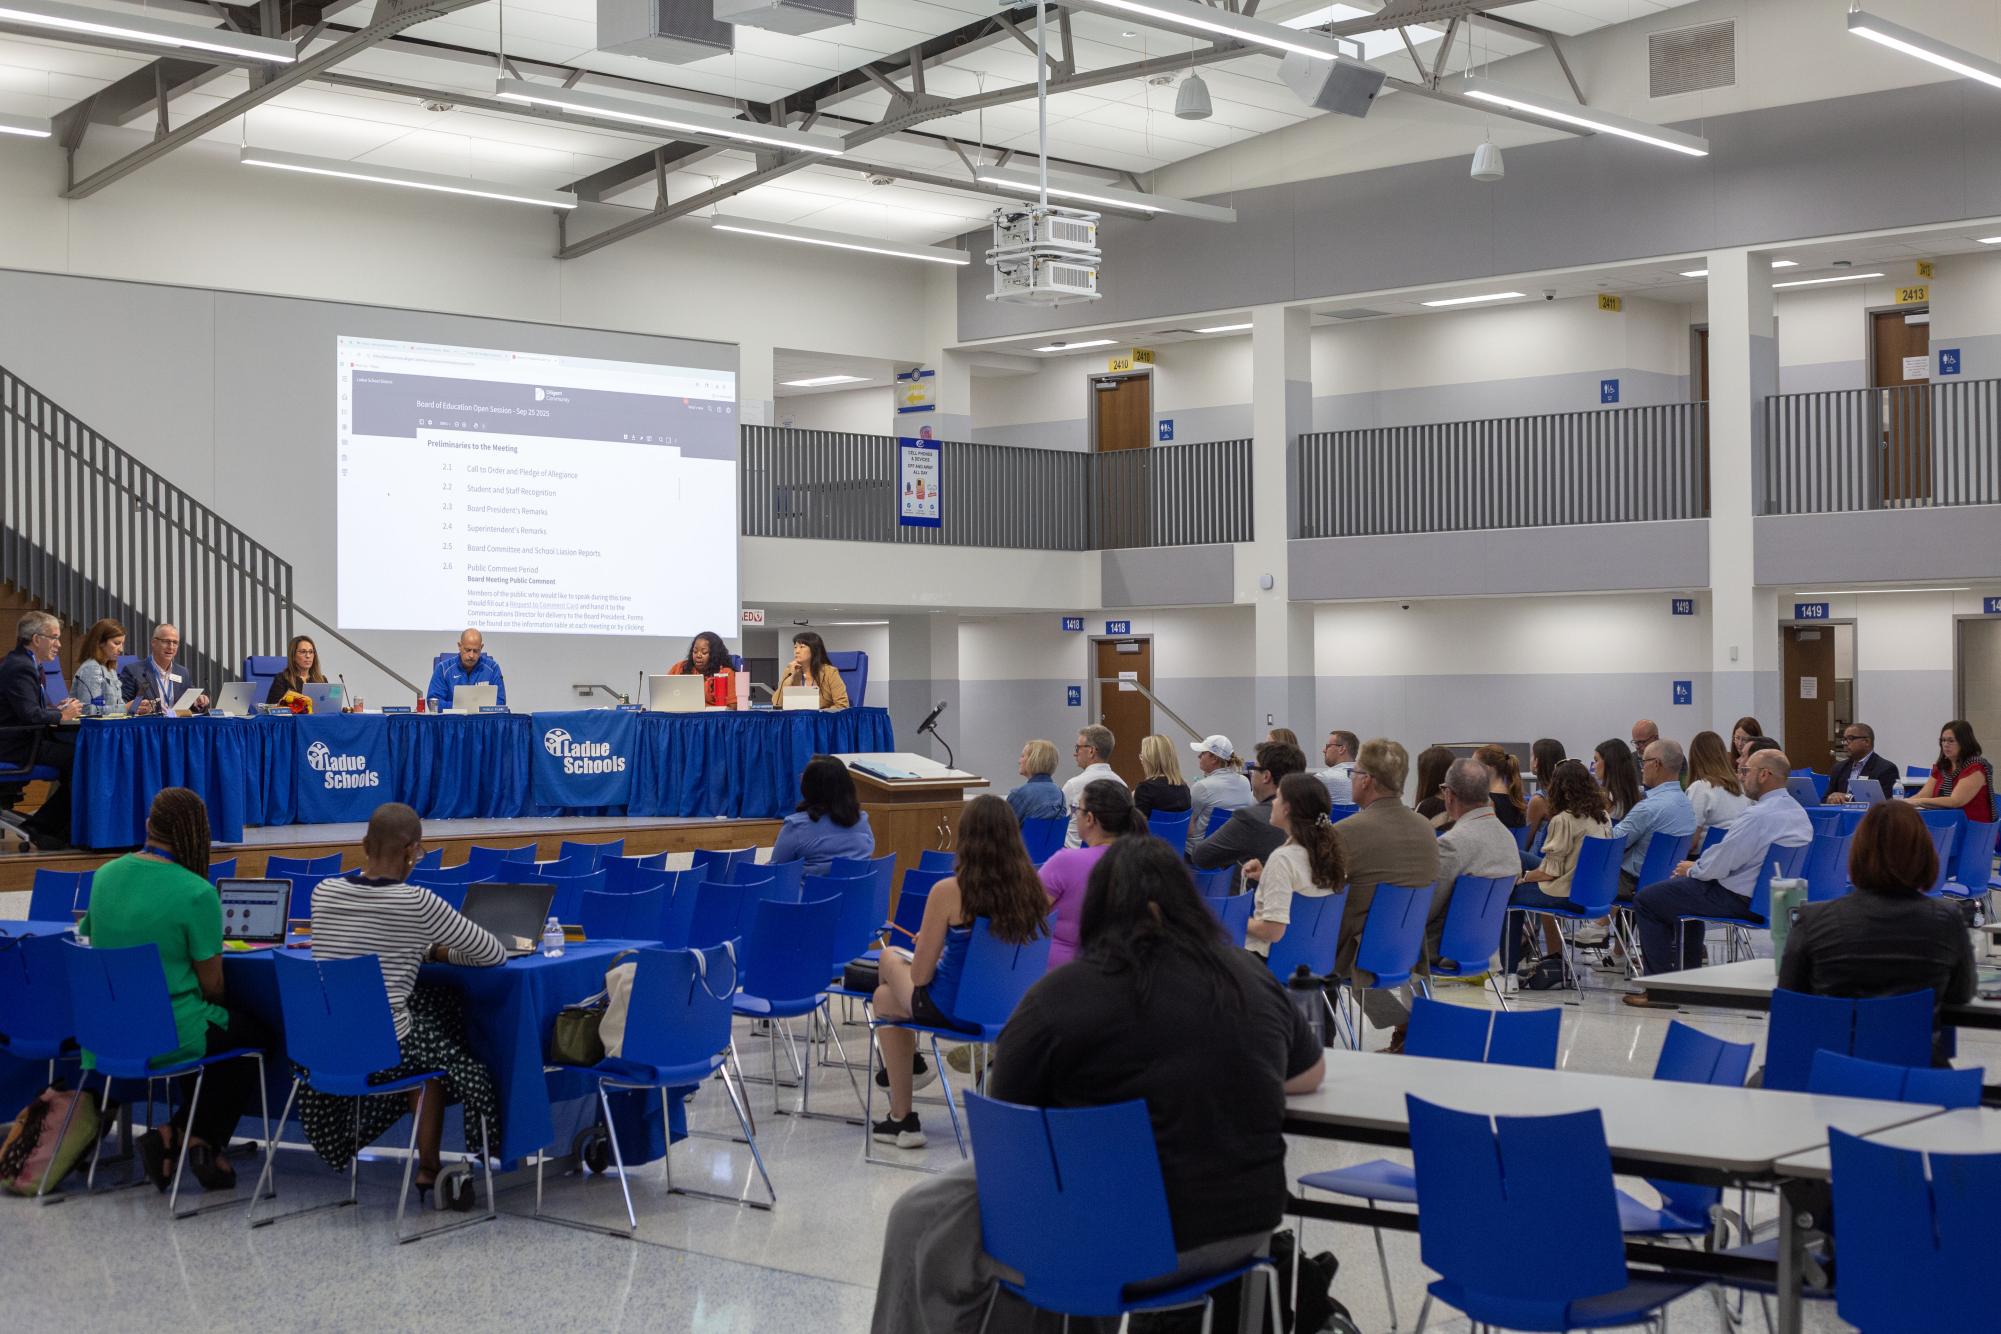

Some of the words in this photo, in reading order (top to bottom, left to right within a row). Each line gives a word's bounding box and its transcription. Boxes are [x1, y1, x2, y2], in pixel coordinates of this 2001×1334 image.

[1902, 288, 1924, 301] 2413
[1603, 297, 1616, 308] 2411
[1136, 351, 1151, 362] 2410
[1114, 360, 1128, 370] 2410
[416, 400, 434, 408] Board
[443, 402, 472, 411] Education
[473, 404, 490, 413] Open
[490, 406, 512, 414] Session
[427, 440, 471, 450] Preliminaries
[493, 444, 518, 453] Meeting
[520, 469, 539, 478] Pledge
[548, 471, 578, 479] Allegiance
[467, 485, 491, 493] Student
[521, 488, 556, 497] Recognition
[487, 506, 520, 514] President's
[522, 507, 548, 516] Remarks
[467, 525, 520, 534] Superintendent's
[521, 527, 547, 535] Remarks
[487, 545, 520, 553] Committee
[578, 548, 600, 557] Reports
[488, 564, 517, 572] Comment
[1802, 605, 1822, 616] 1419
[742, 612, 753, 621] ED
[1066, 619, 1080, 630] 1418
[1111, 622, 1126, 632] 1418
[564, 740, 610, 757] Ladue
[324, 754, 366, 771] Ladue
[564, 756, 626, 774] Schools
[324, 770, 379, 789] Schools
